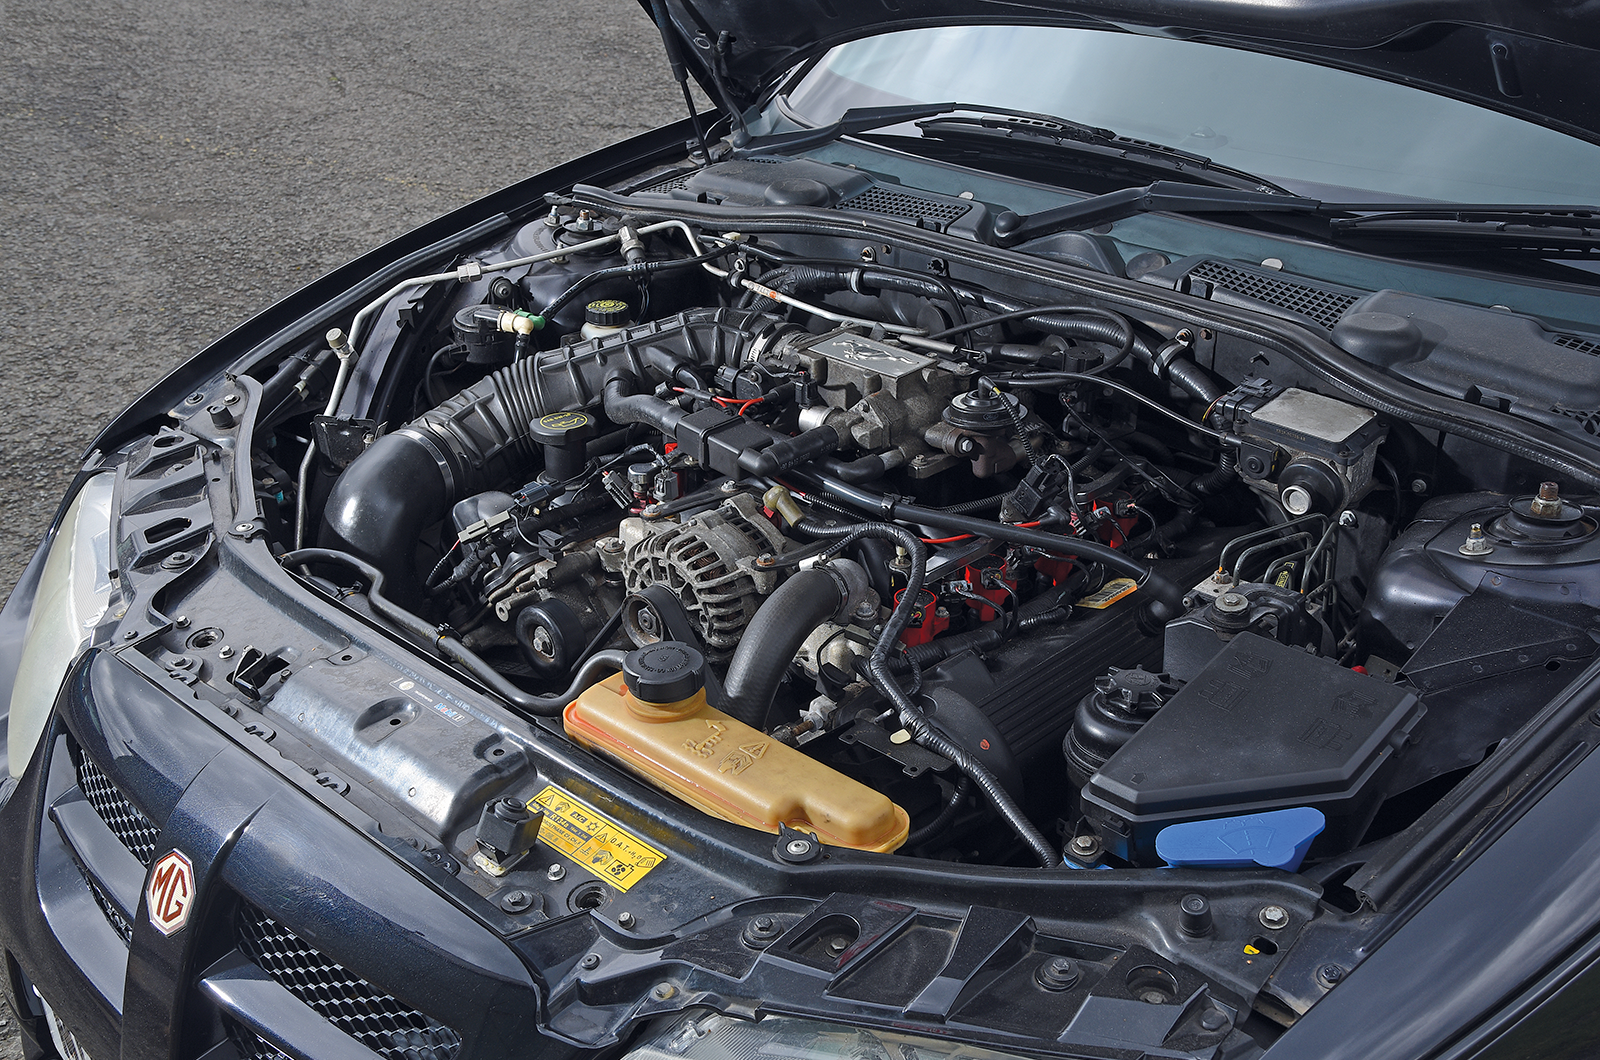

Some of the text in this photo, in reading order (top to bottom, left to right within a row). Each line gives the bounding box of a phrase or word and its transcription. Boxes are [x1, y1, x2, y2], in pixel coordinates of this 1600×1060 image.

[550, 813, 569, 828] R134a
[572, 812, 586, 823] A/C
[152, 862, 187, 923] MG
